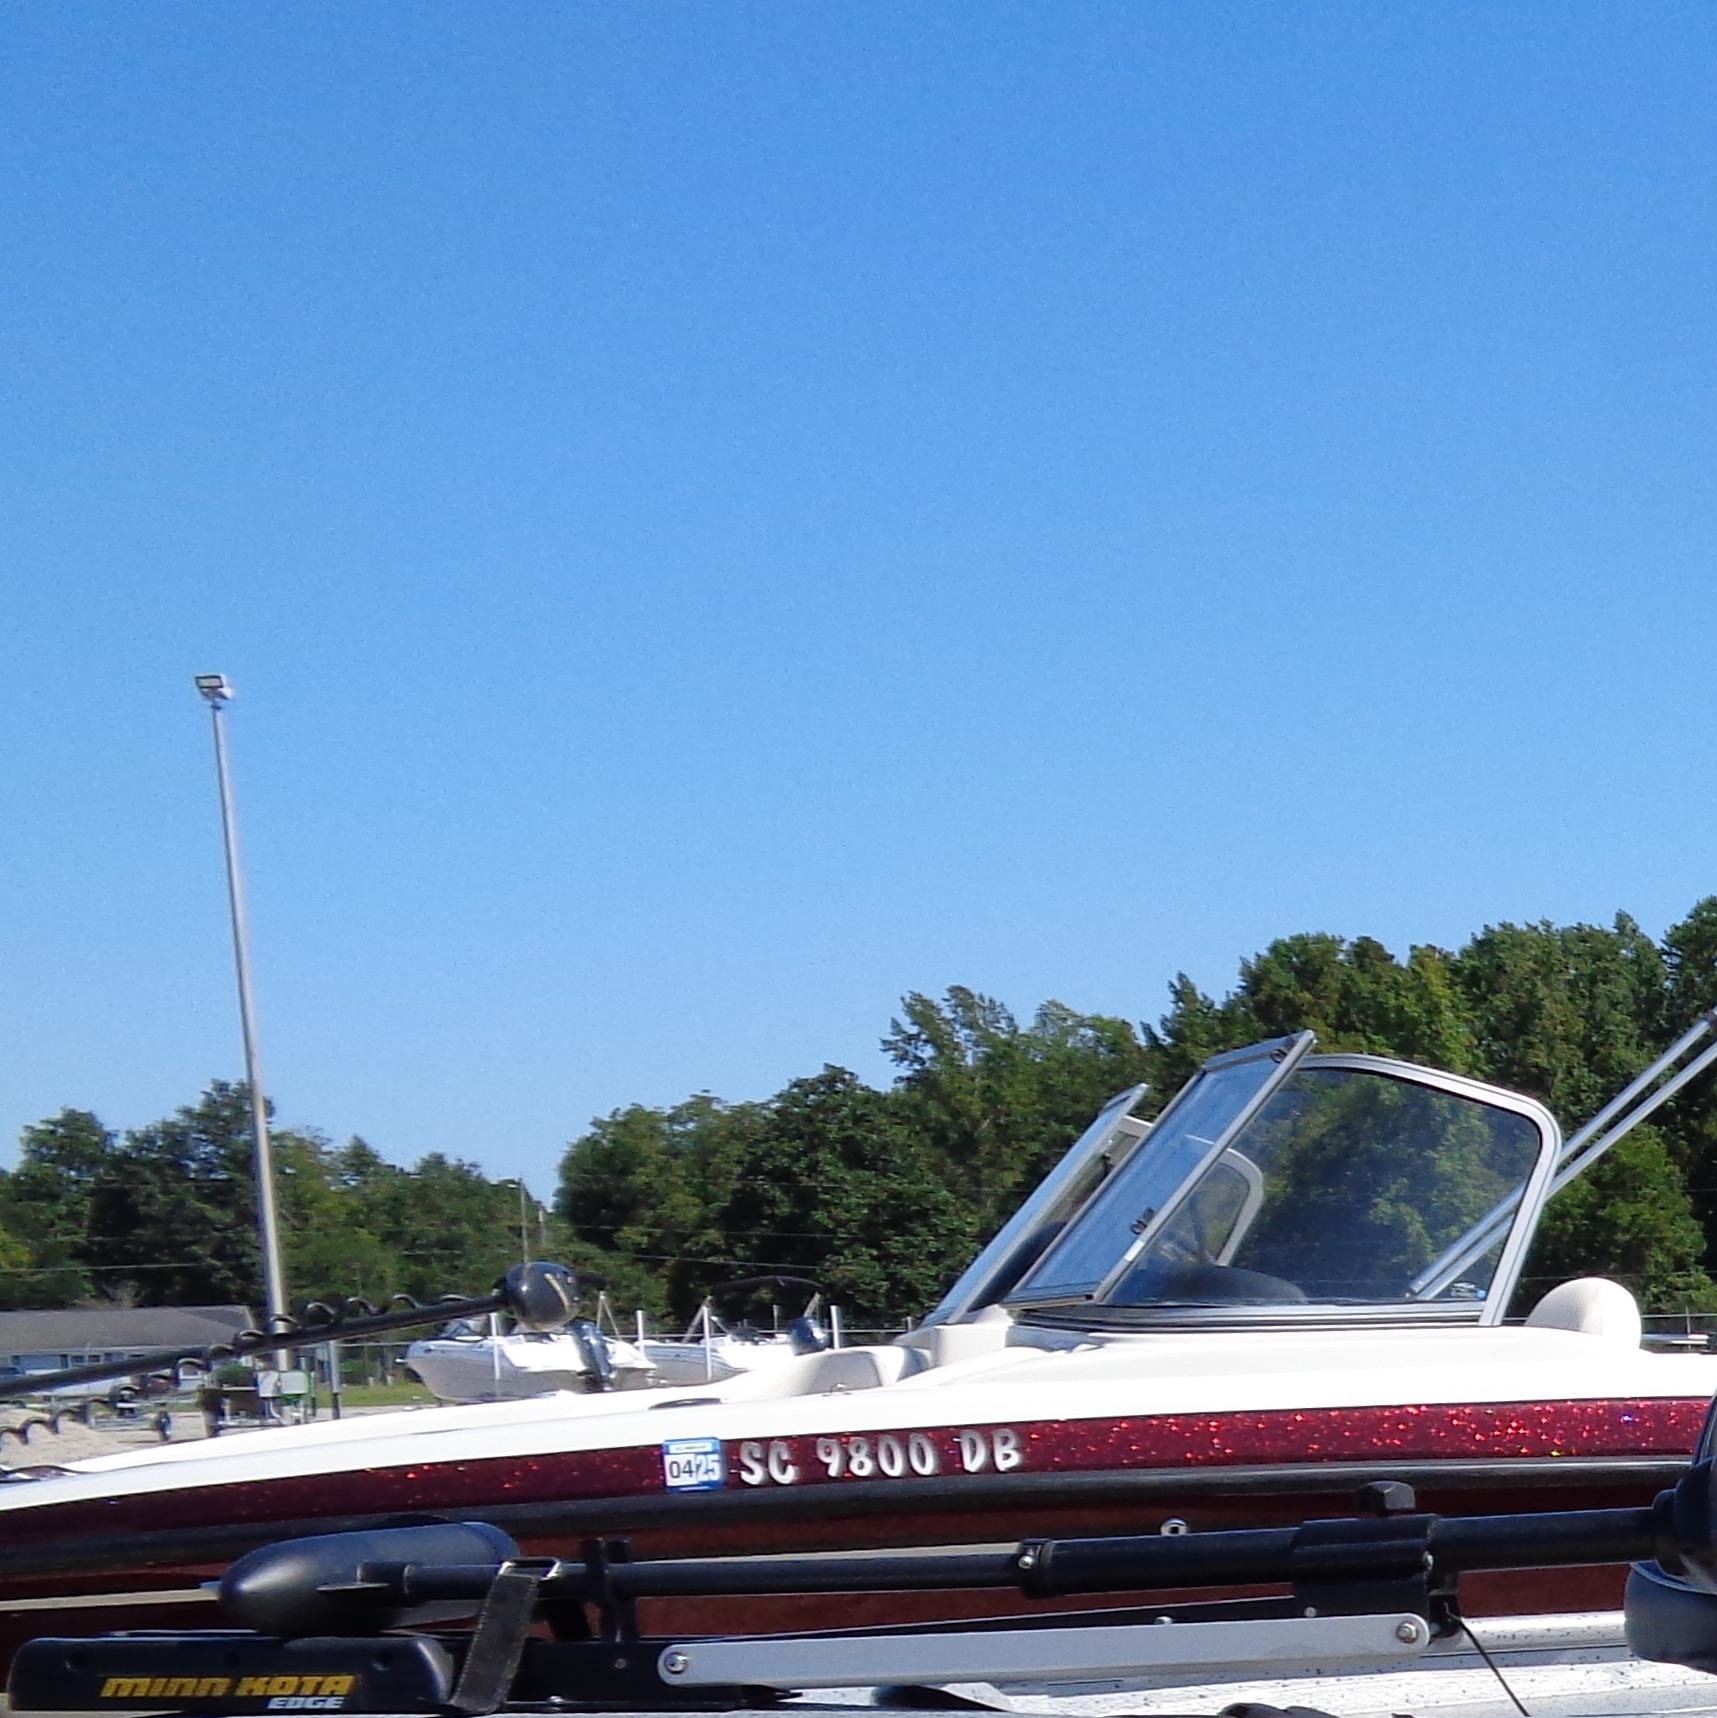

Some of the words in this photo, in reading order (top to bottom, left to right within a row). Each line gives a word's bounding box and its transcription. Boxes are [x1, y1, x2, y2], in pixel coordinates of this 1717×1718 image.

[739, 1439, 797, 1486] SC
[815, 1432, 938, 1478] 9800
[957, 1428, 1024, 1473] DB
[669, 1459, 694, 1479] 04
[234, 1675, 355, 1697] KOTA
[267, 1696, 345, 1709] EDGE
